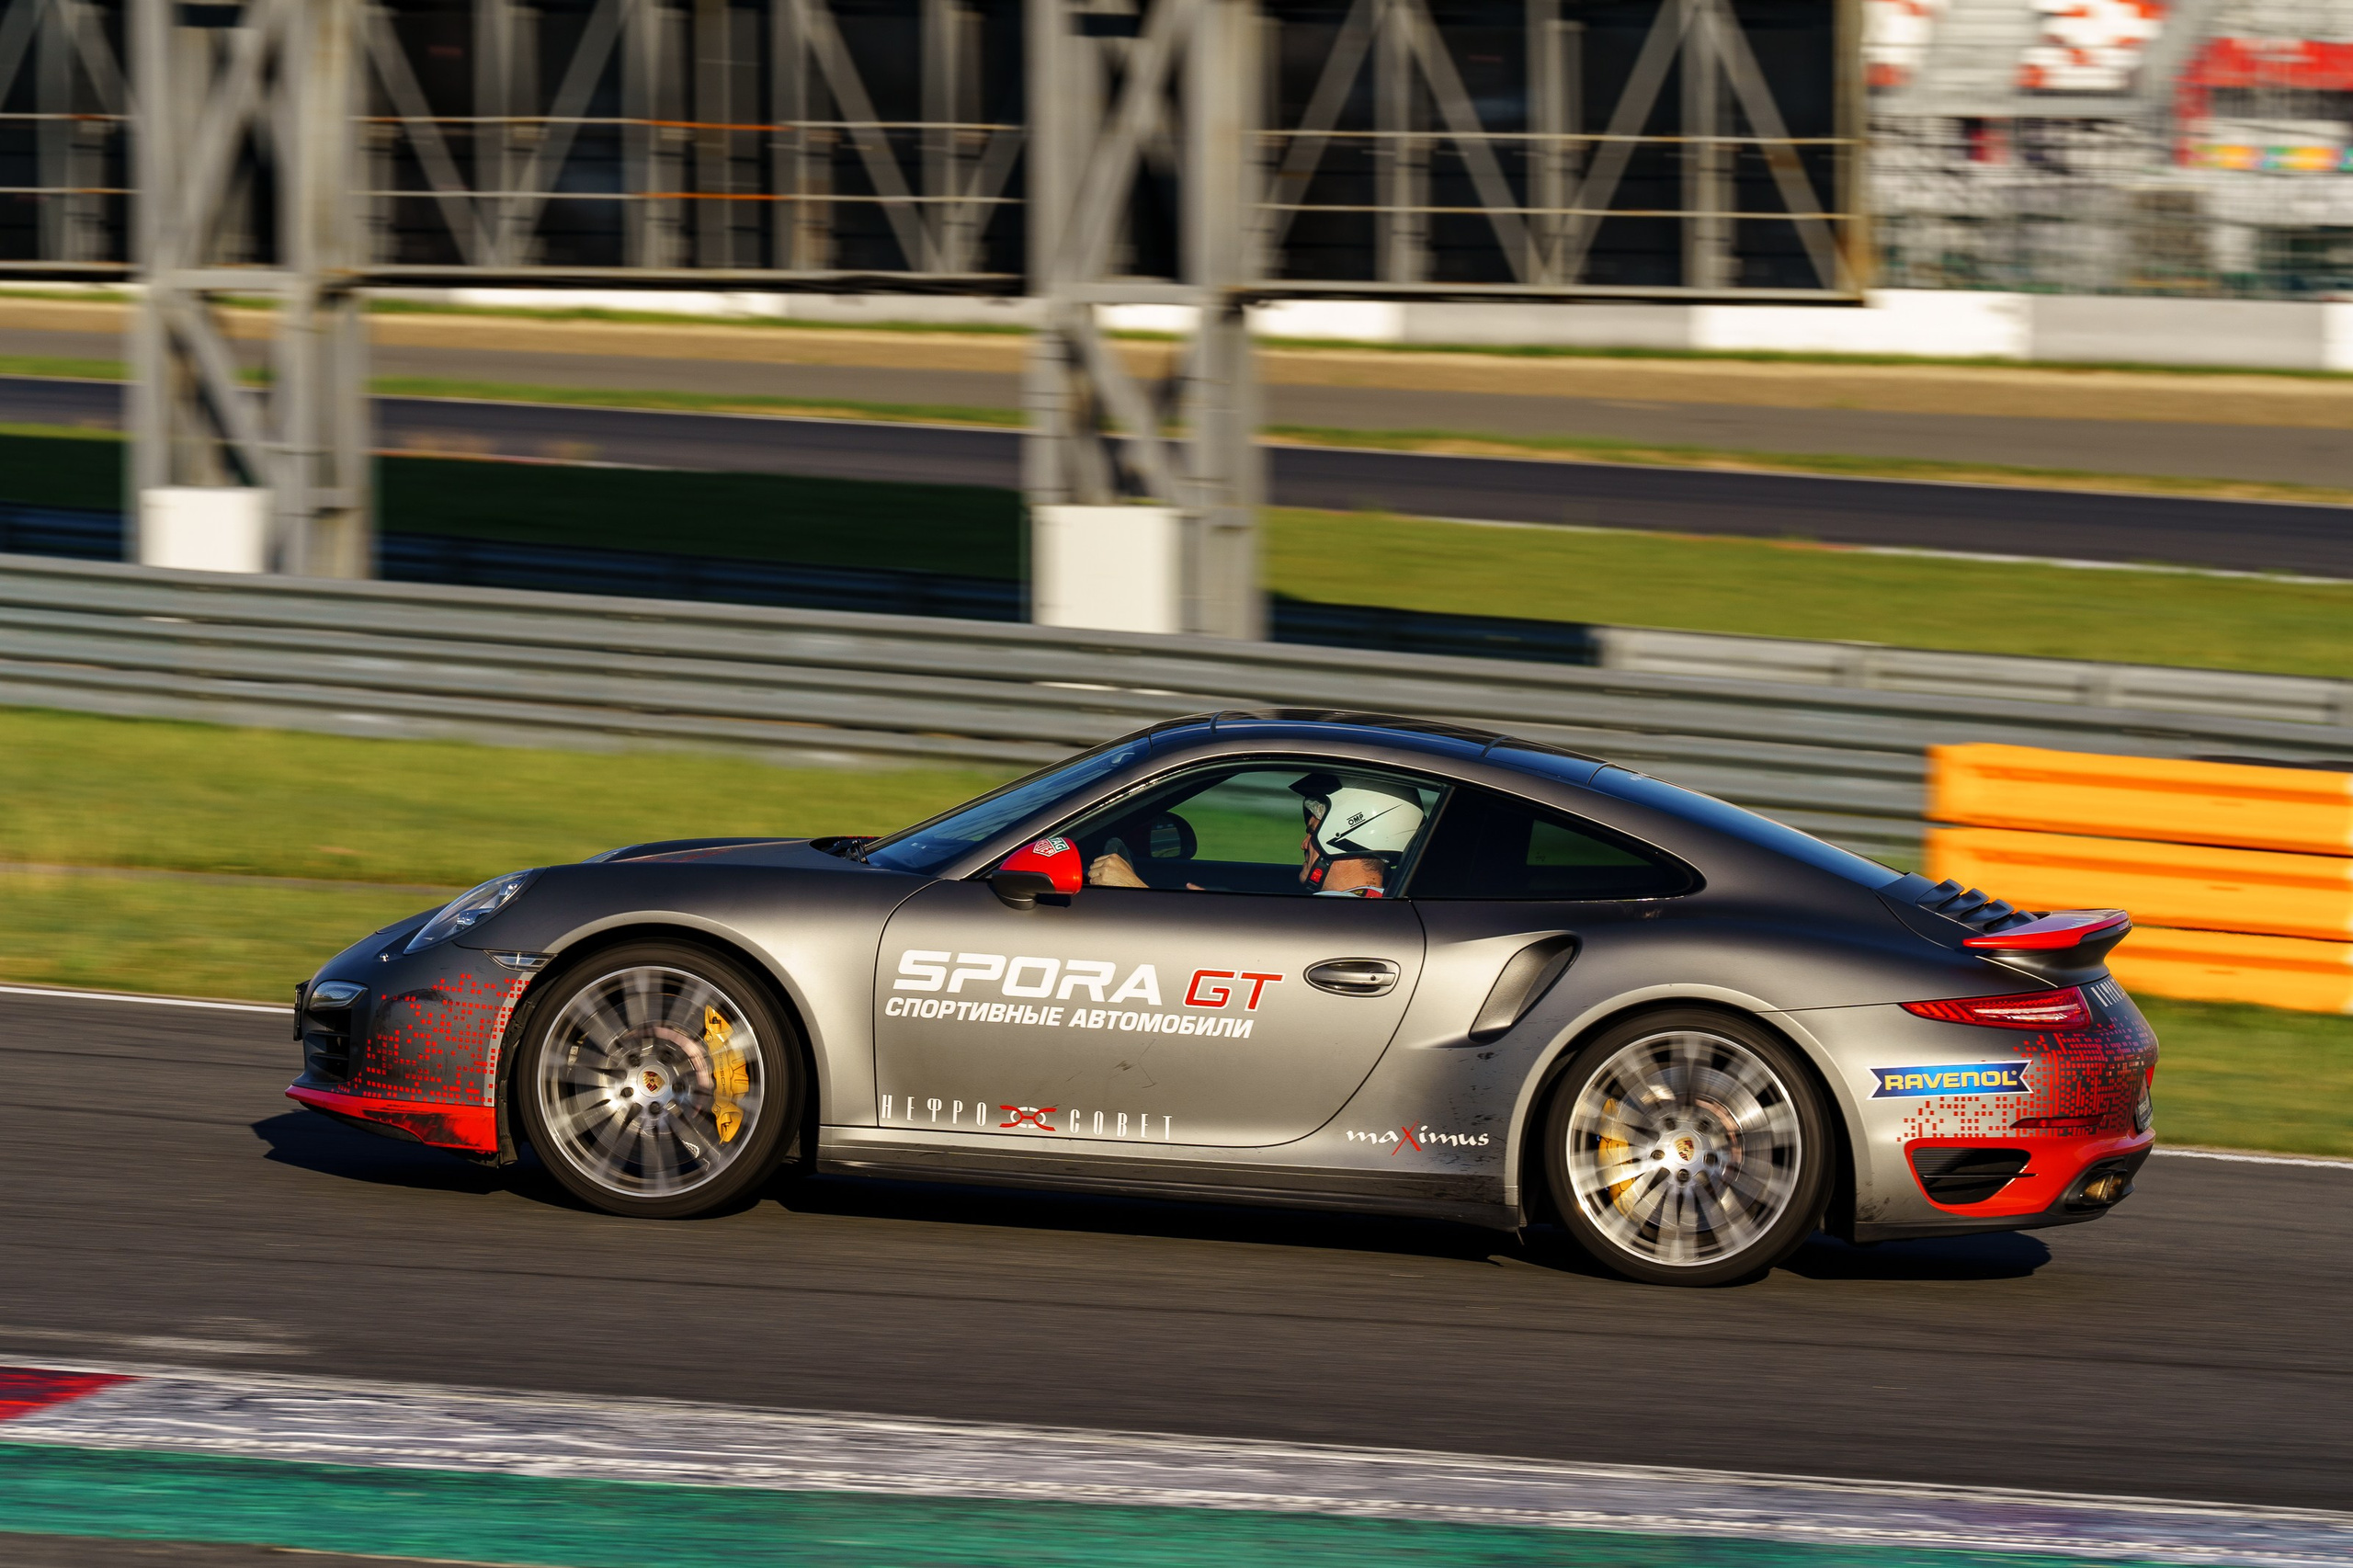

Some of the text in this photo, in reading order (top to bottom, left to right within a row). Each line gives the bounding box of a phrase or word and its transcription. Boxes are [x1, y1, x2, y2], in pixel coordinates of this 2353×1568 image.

[1347, 812, 1365, 826] OMP
[1051, 837, 1067, 851] TAG
[892, 949, 1287, 1013] SPORA GT
[885, 996, 1255, 1039] СПОРТИВНЫЕ АВТОМОБИЛИ
[1884, 1069, 2018, 1091] RAVENOL
[881, 1094, 1173, 1141] НЕФРО СОВЕТ
